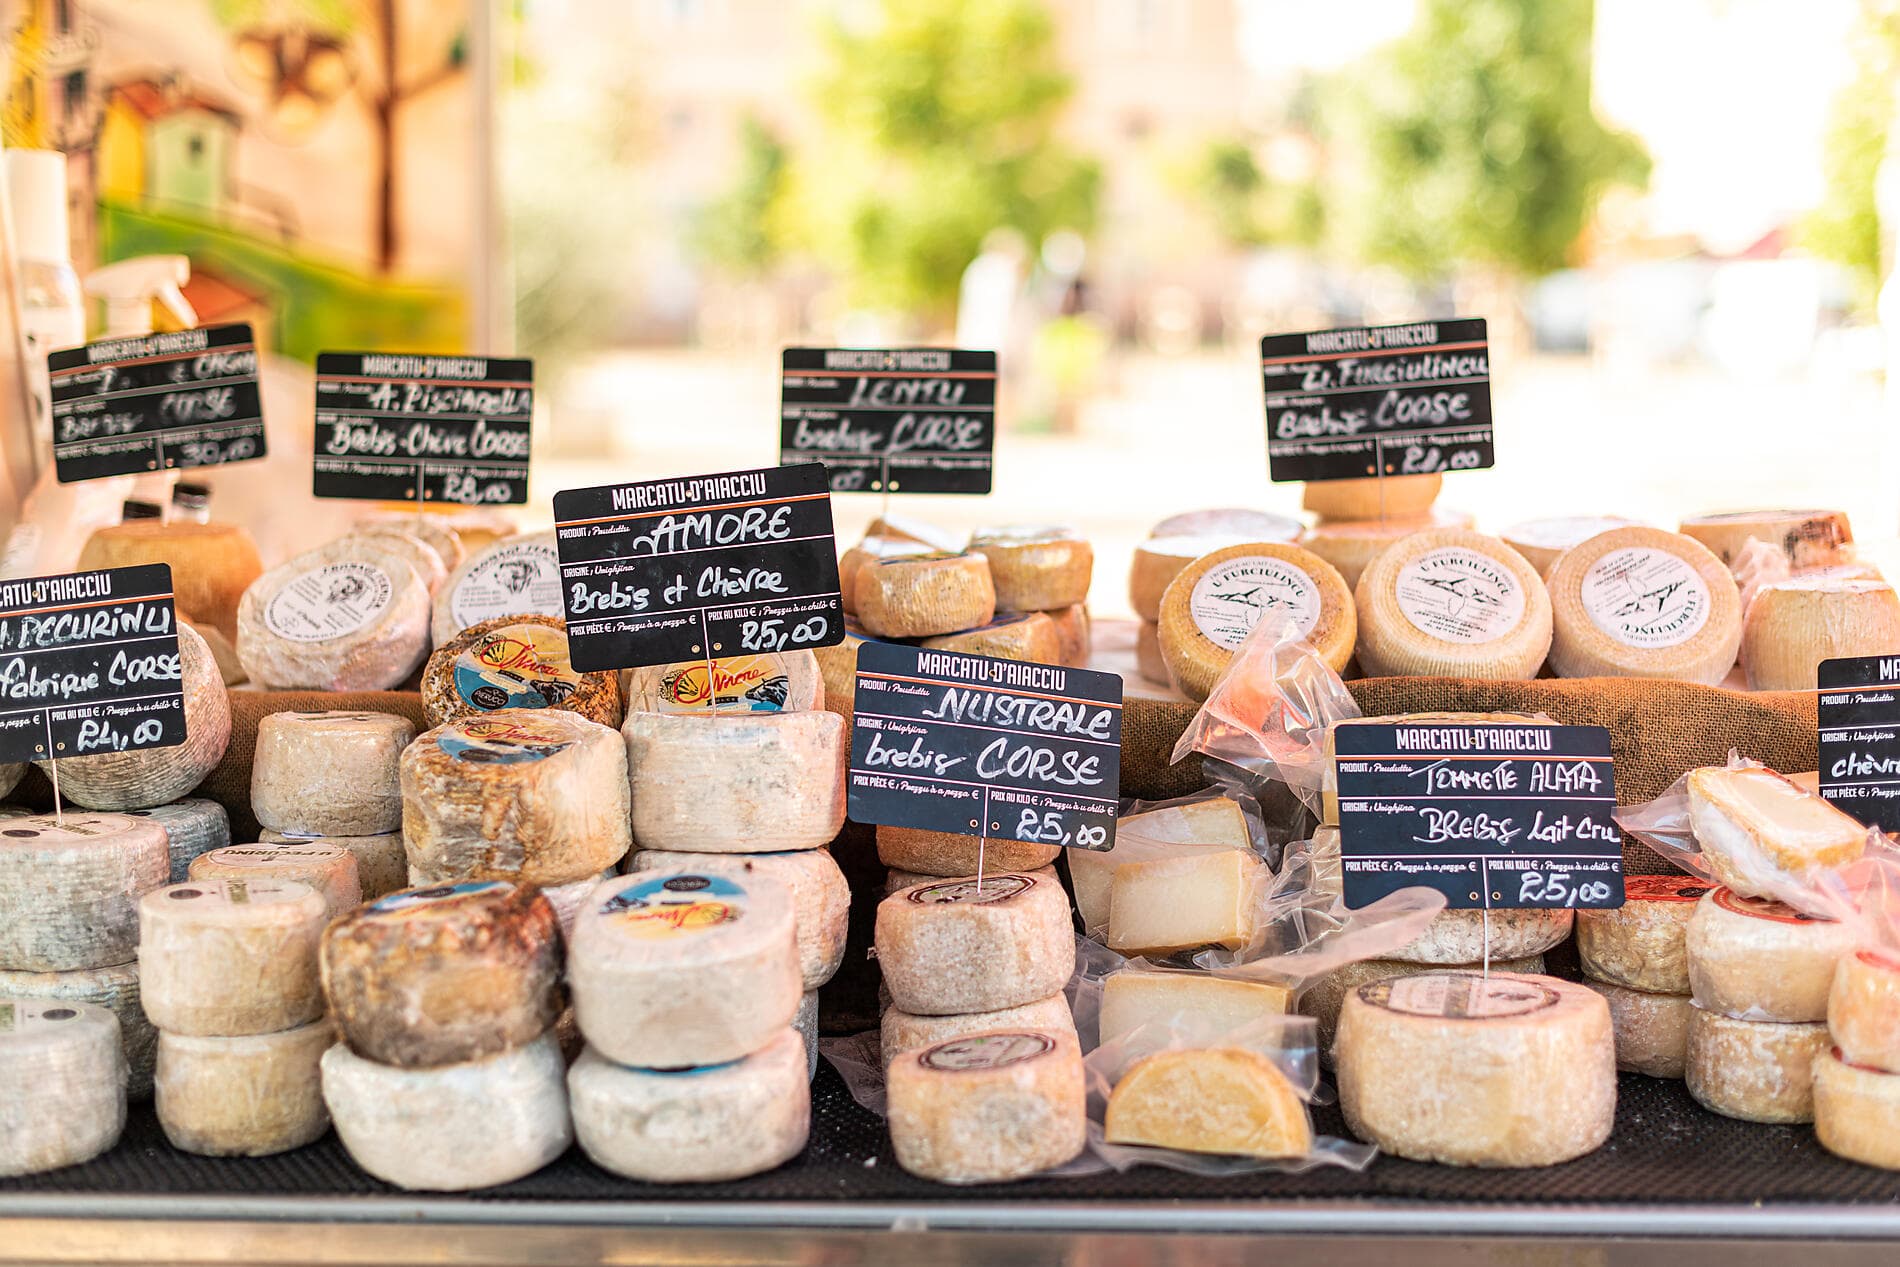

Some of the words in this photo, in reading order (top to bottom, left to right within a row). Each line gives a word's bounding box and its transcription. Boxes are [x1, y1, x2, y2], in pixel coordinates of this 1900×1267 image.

[612, 484, 686, 511] MARCATU
[690, 473, 766, 503] D'AIACCIU
[560, 527, 587, 540] PRODUIT
[632, 506, 792, 554] AMORE
[563, 566, 590, 578] ORIGINE
[36, 574, 112, 603] D'AIACCIU
[570, 581, 650, 614] Brebis
[664, 574, 688, 604] et
[696, 565, 789, 598] Chèvre
[707, 610, 723, 621] PRIX
[724, 609, 733, 620] AU
[734, 608, 749, 619] KILO
[829, 599, 837, 609] €
[18, 603, 171, 649] PECURINU
[570, 625, 586, 637] PRIX
[741, 616, 828, 651] 25,00
[917, 652, 989, 680] MARCATU
[993, 662, 1066, 691] D'AIACCIU
[859, 679, 887, 691] PRODUIT
[52, 711, 66, 722] PRIX
[67, 710, 77, 721] AU
[78, 708, 92, 719] KILO
[172, 699, 180, 709] €
[1821, 695, 1849, 706] PRODUIT
[857, 717, 883, 730] ORIGINE
[922, 688, 1112, 740] NUSTRALE
[1395, 729, 1470, 750] MARCATU
[1474, 729, 1551, 751] D'AIACCIU
[1821, 732, 1848, 742] ORIGINE
[864, 732, 968, 775] brebis
[976, 737, 1103, 786] CORSE
[1340, 762, 1368, 772] PRODUIT
[853, 775, 869, 786] PRIX
[971, 789, 980, 800] €
[1529, 760, 1602, 793] ALATA
[990, 790, 1006, 801] PRIX
[1006, 792, 1016, 803] AU
[1016, 793, 1031, 804] KILO
[1107, 806, 1114, 816] €
[1822, 789, 1838, 798] PRIX
[1342, 802, 1368, 812] ORIGINE
[1015, 808, 1107, 846] 25,00
[1576, 817, 1621, 843] Cru
[1345, 861, 1361, 871] PRIX
[1468, 861, 1476, 871] €
[1488, 860, 1504, 870] PRIX
[1611, 862, 1619, 872] €
[1519, 872, 1611, 907] 25,00
